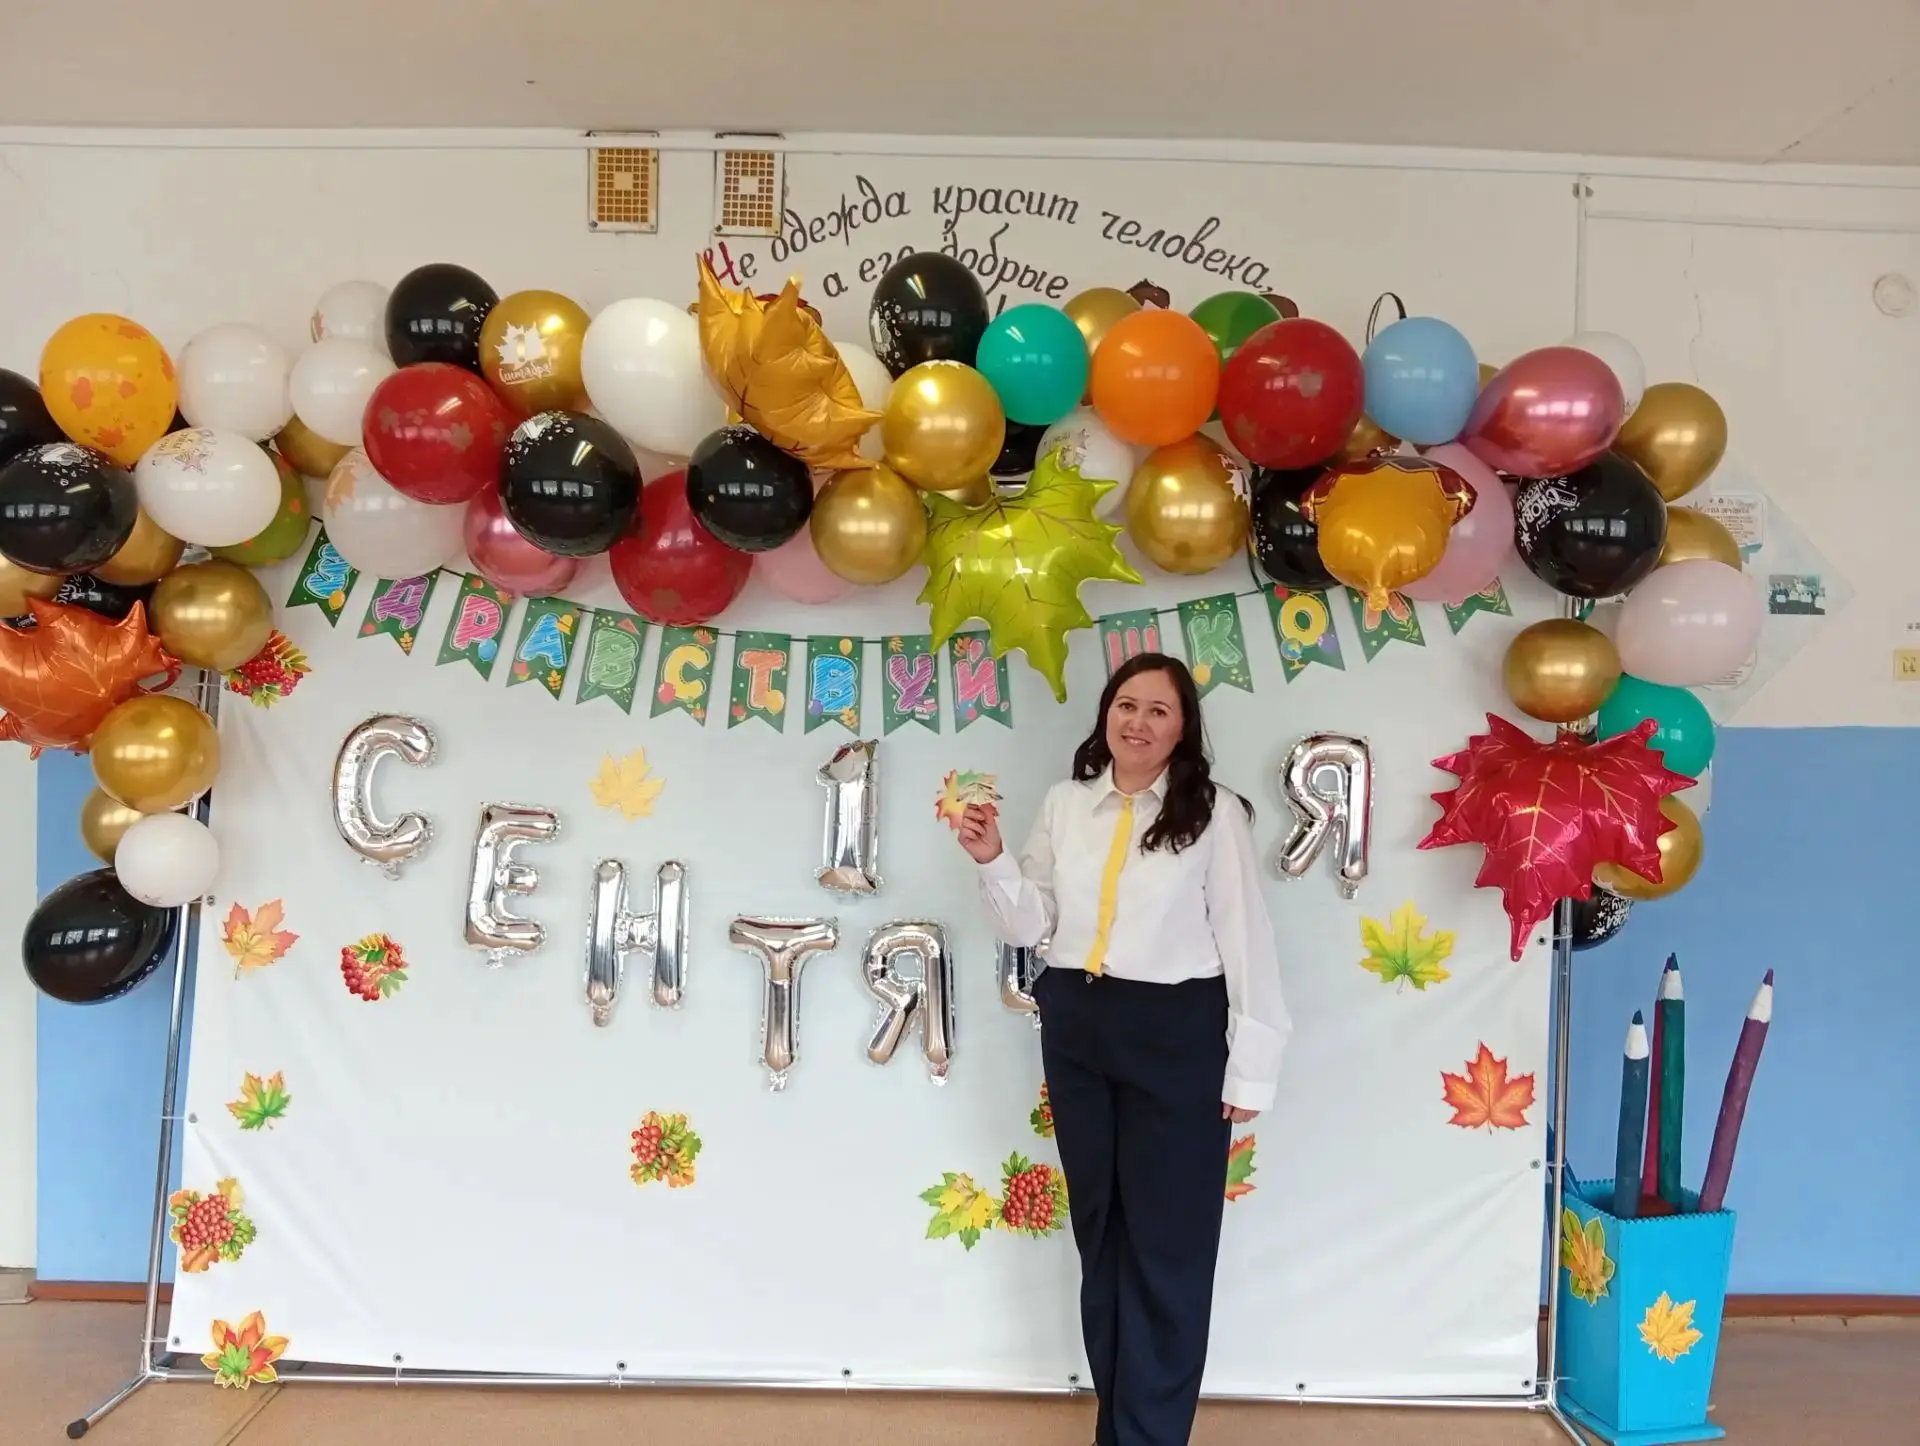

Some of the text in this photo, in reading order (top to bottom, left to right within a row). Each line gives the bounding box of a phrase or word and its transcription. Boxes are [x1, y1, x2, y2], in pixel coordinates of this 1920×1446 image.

[771, 174, 911, 262] одежда
[933, 184, 1079, 236] красит
[1101, 211, 1274, 294] человека,
[823, 271, 849, 298] а
[814, 739, 885, 894] 1
